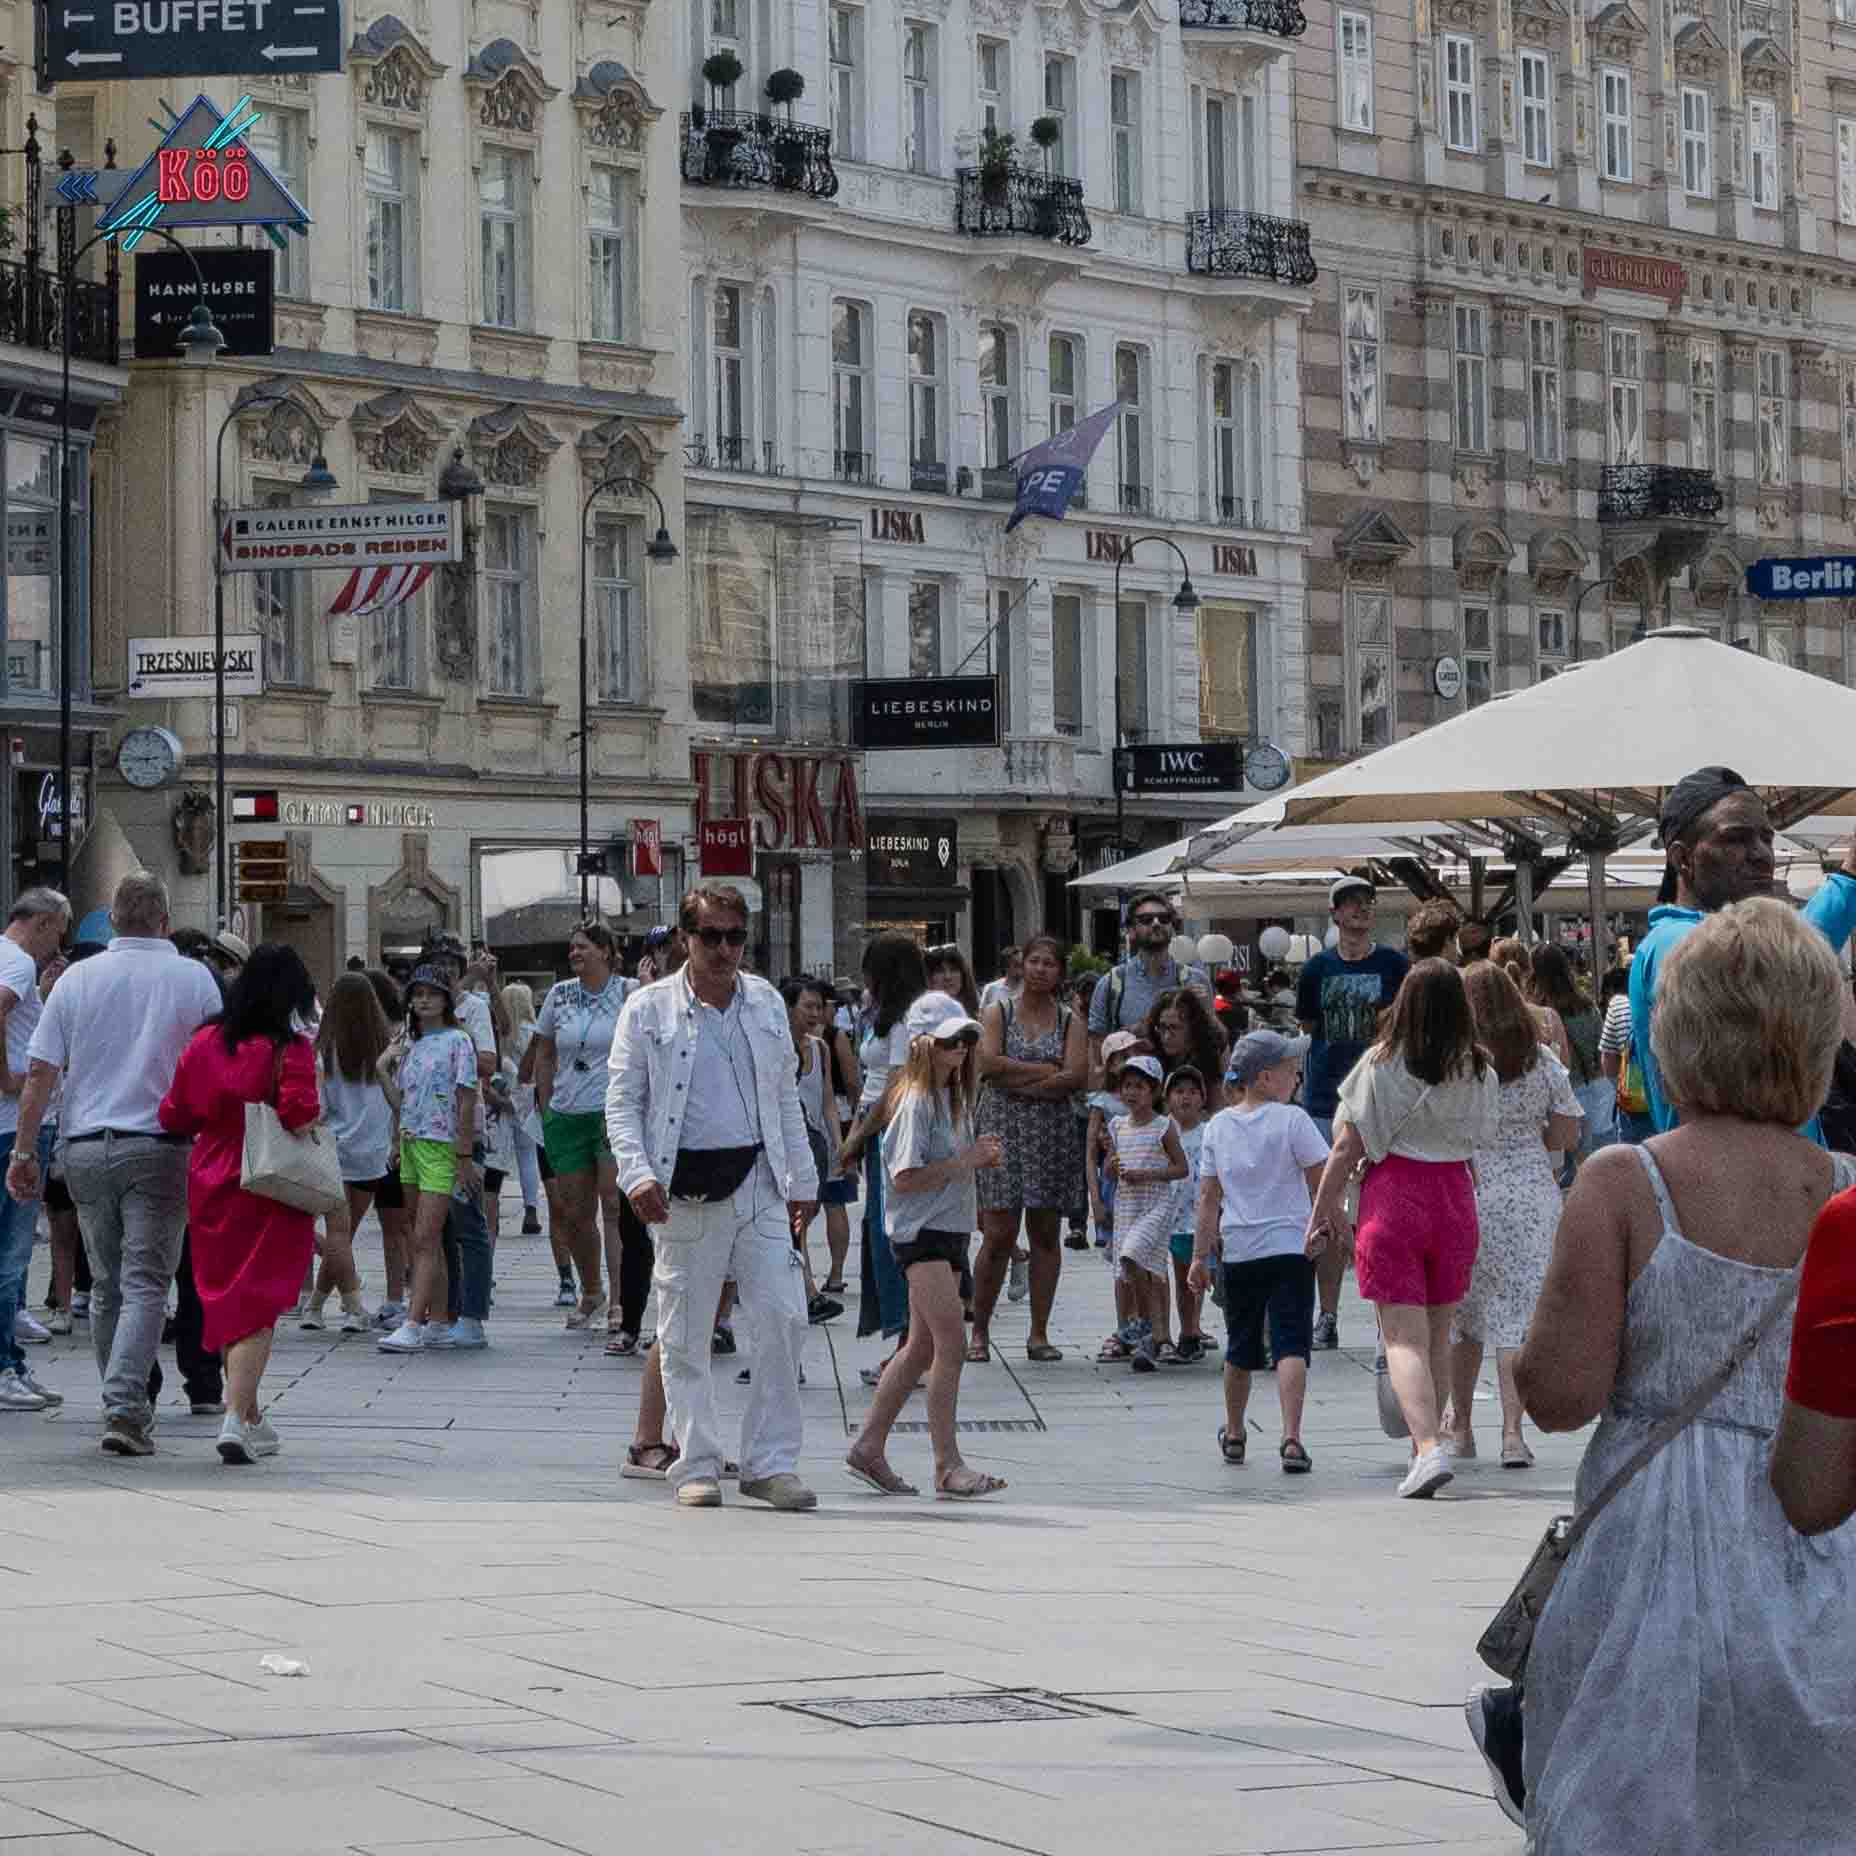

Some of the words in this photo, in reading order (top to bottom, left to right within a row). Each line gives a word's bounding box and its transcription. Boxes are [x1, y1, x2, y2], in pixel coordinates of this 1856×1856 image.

[255, 520, 324, 532] GALERIE
[329, 517, 381, 529] ERNST
[385, 513, 448, 527] HILGER
[871, 508, 926, 545] LISKA
[365, 538, 448, 555] REISEN
[1086, 529, 1135, 564] LISKA
[1213, 544, 1259, 577] LISKA
[871, 698, 993, 716] LIEBESKIND
[913, 719, 949, 730] BERLIN
[1159, 750, 1205, 772] IWC
[1143, 775, 1221, 786] SCHAFFHAUSEN
[695, 751, 864, 851] LISKA
[870, 836, 929, 852] LIEBESKIND
